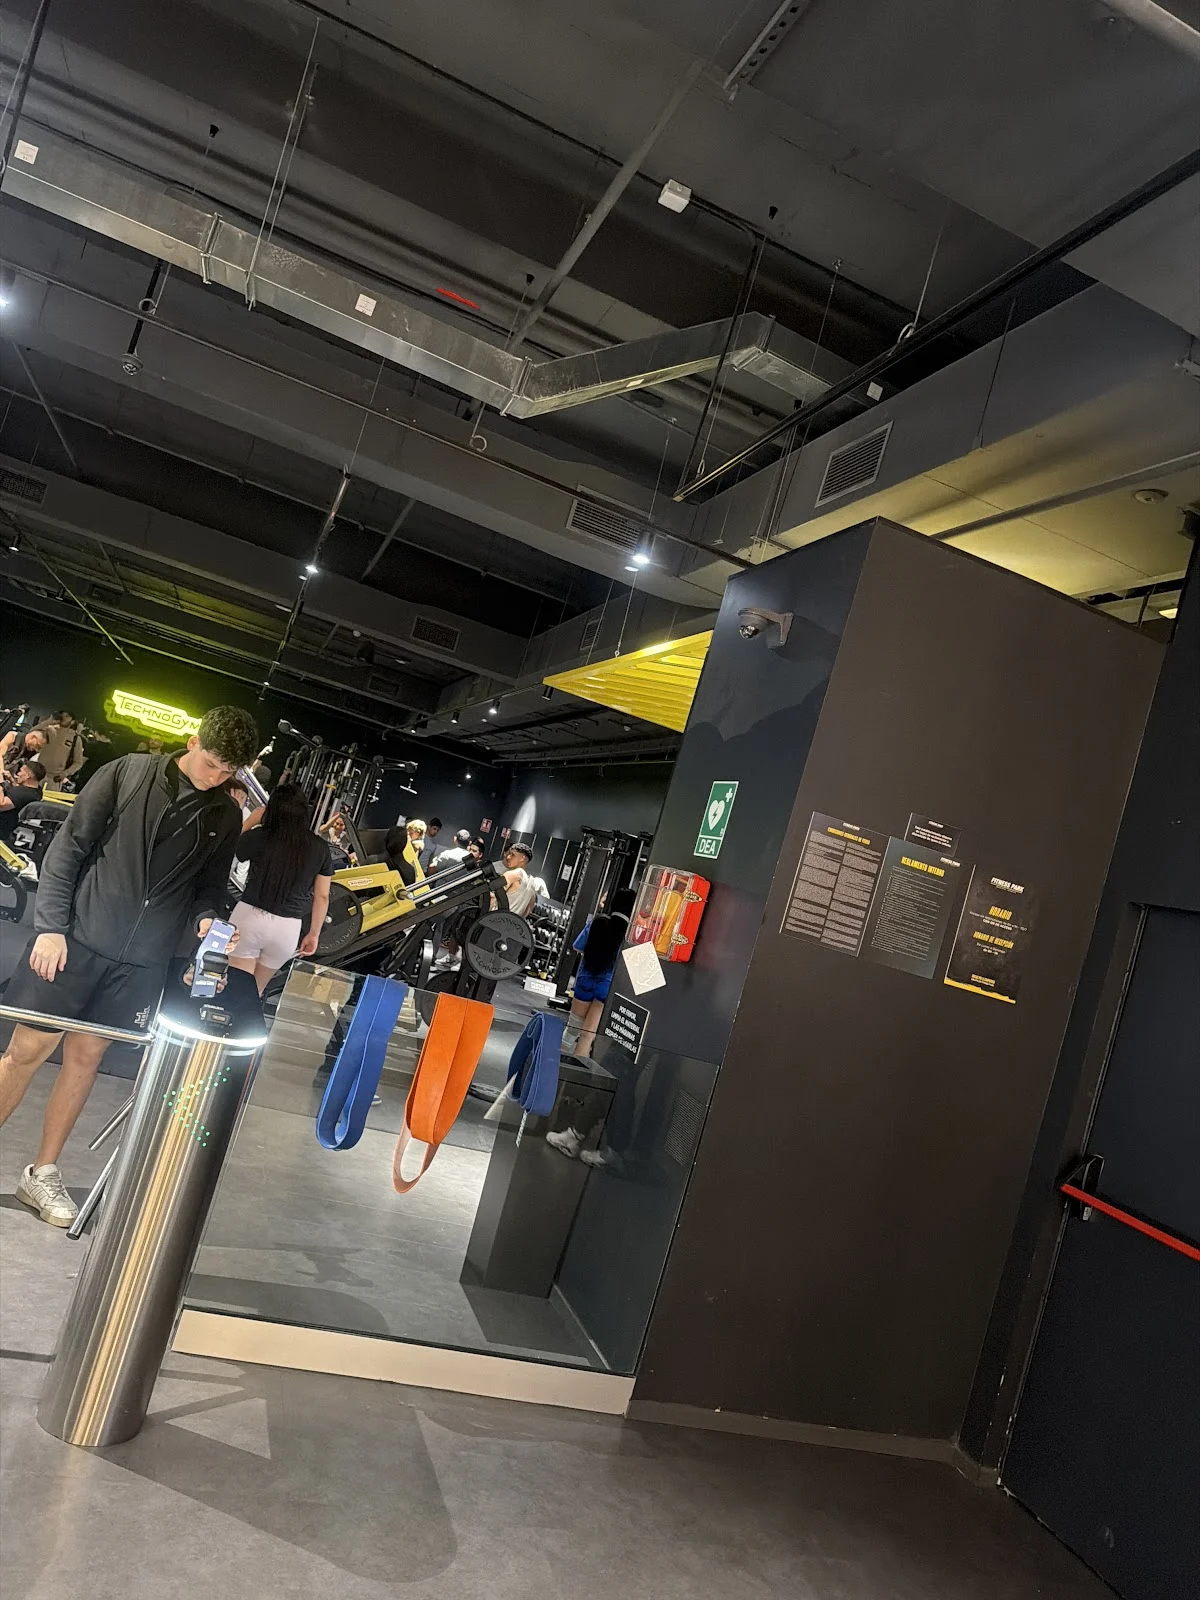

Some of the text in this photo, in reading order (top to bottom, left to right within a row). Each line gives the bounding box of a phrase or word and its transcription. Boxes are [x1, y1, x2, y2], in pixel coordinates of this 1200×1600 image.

[698, 838, 717, 855] DEA
[901, 856, 945, 877] REGLAMENTO INTERNO
[990, 877, 1011, 888] FITNESS
[1010, 883, 1025, 893] PARK
[988, 905, 1013, 921] HORARIO
[973, 931, 989, 942] HORARIO
[988, 935, 995, 944] DE
[618, 1005, 627, 1015] POR
[620, 1017, 625, 1025] EL
[624, 1019, 641, 1034] MATERIAL
